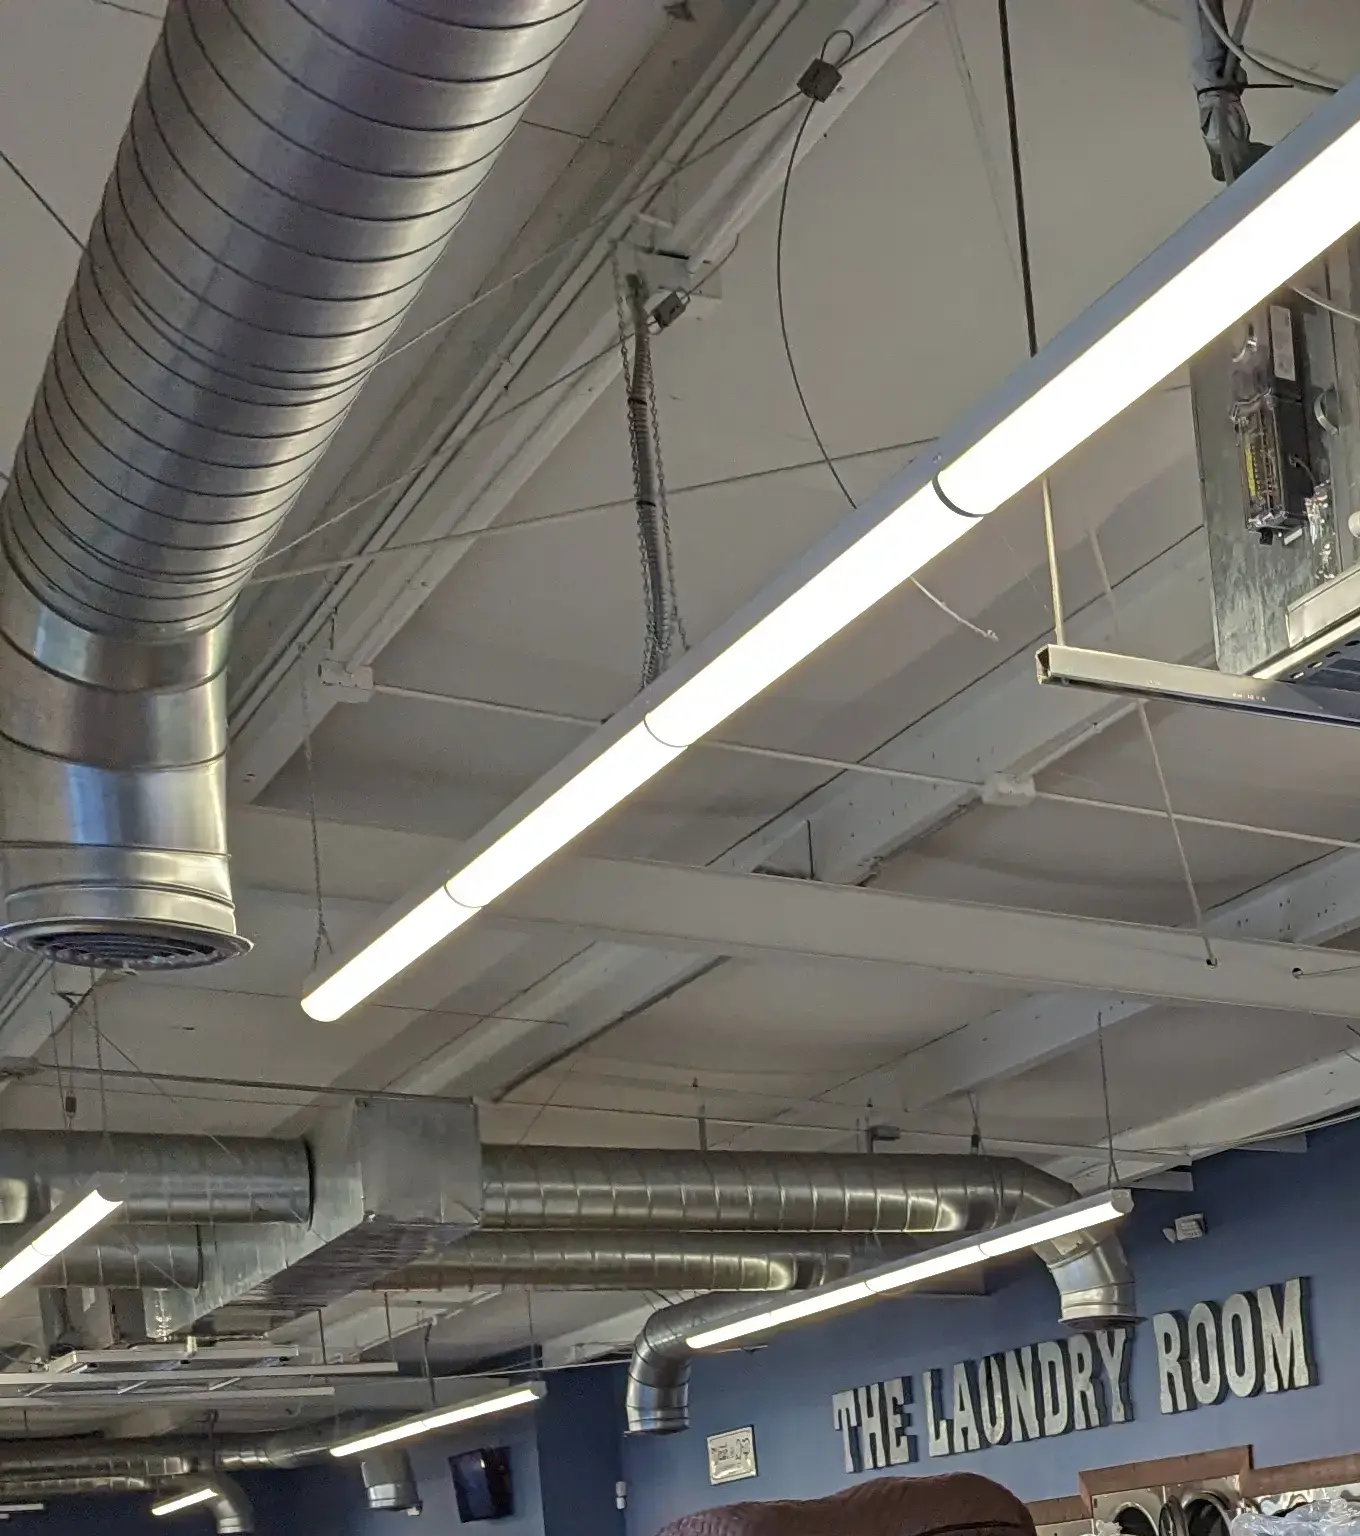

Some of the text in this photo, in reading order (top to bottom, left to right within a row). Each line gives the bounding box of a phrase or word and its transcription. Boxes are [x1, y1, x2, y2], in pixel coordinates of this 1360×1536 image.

[832, 1277, 1317, 1472] THE LAUNDRY ROOM
